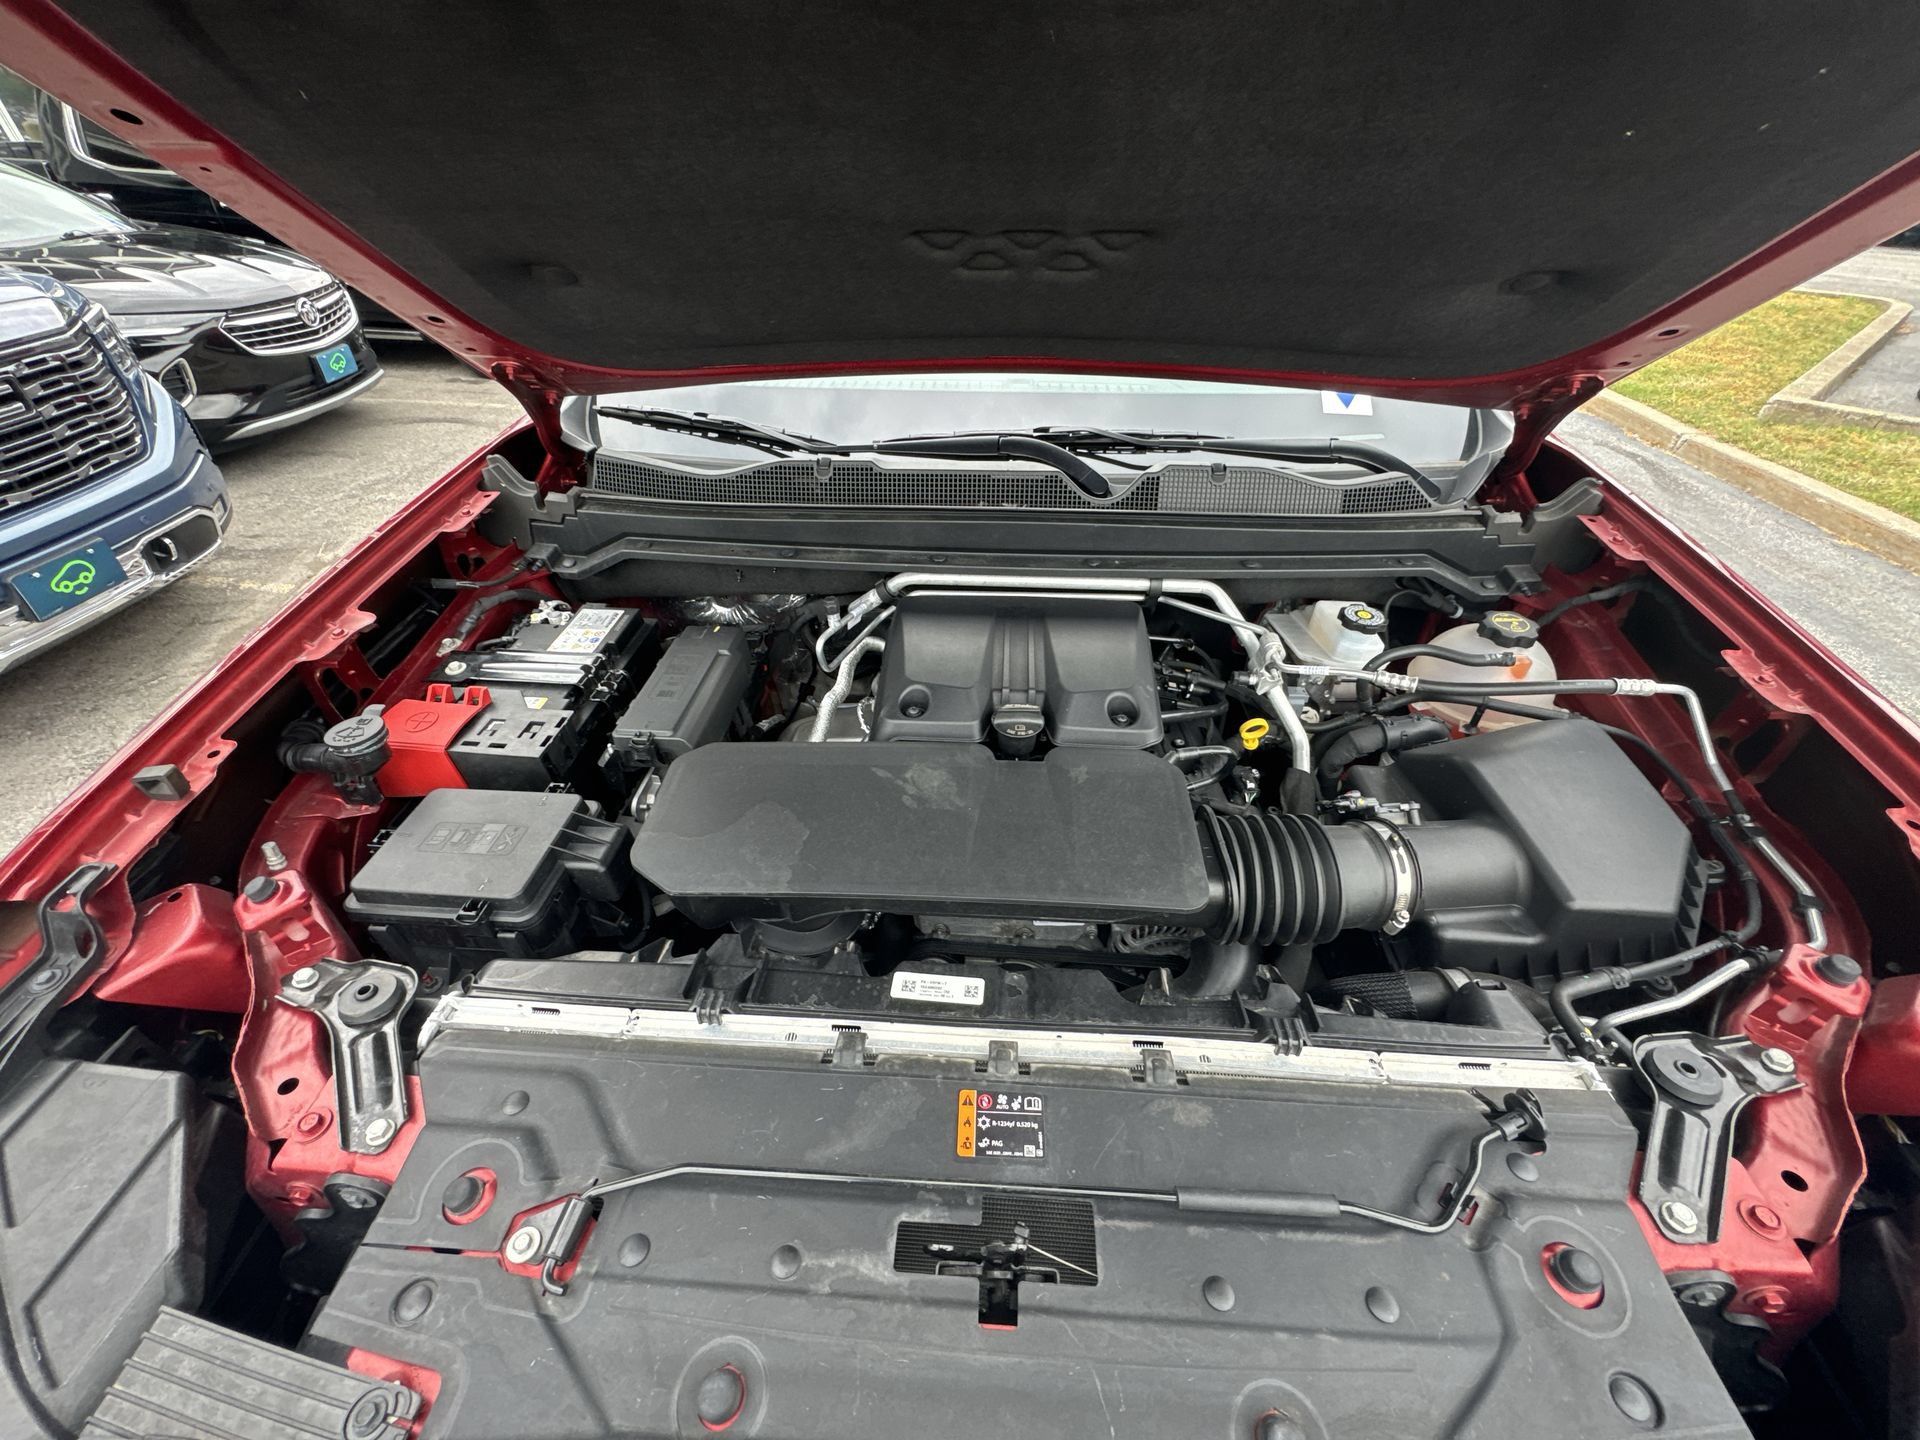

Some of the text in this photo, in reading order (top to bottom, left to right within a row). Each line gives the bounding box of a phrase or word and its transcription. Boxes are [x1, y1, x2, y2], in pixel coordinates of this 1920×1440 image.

[992, 1120, 1015, 1128] R-1234yf
[1031, 1121, 1039, 1130] kg
[992, 1139, 1003, 1147] PAG
